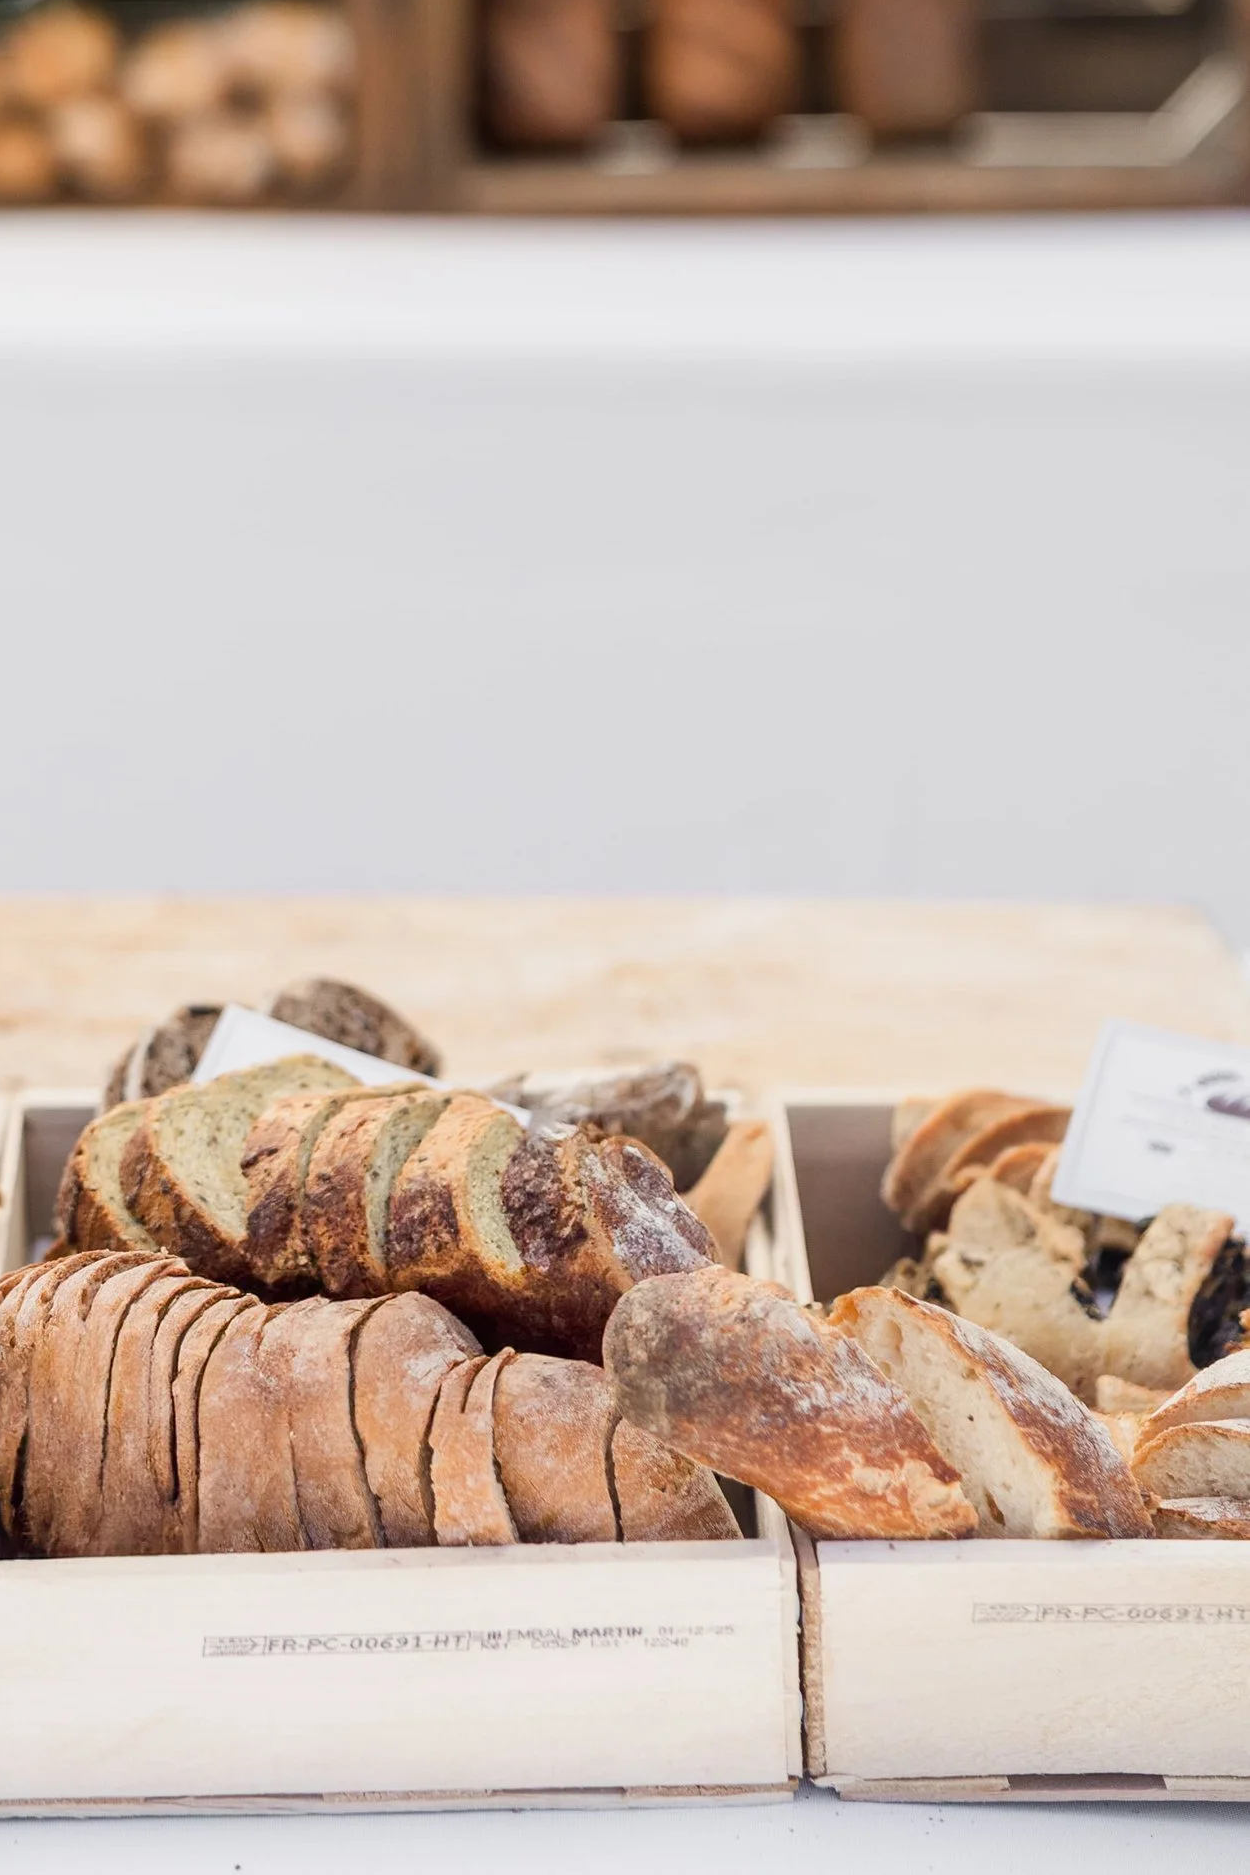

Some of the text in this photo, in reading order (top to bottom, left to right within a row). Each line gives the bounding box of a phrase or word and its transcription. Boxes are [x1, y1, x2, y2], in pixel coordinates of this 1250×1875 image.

[1042, 1605, 1250, 1620] FR-PC-00691-HT
[571, 1626, 643, 1639] MARTIN
[267, 1633, 466, 1652] FR-PC-00691-HT
